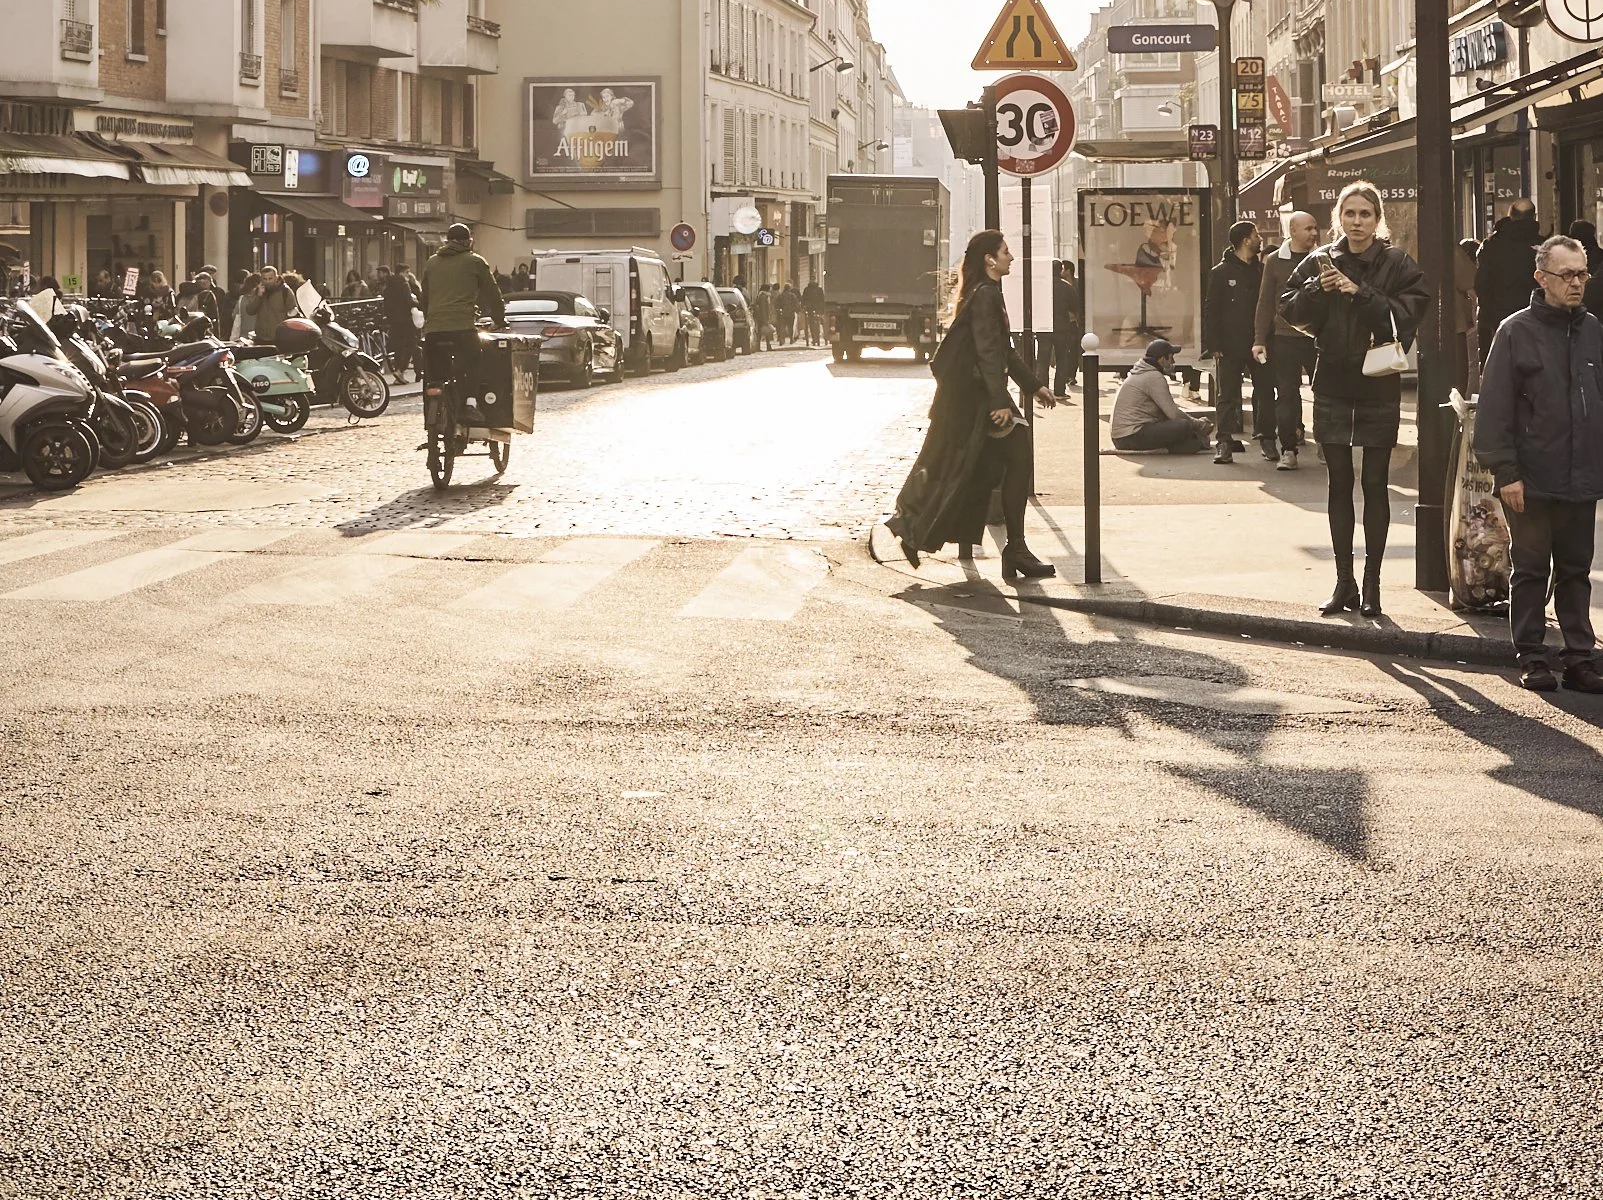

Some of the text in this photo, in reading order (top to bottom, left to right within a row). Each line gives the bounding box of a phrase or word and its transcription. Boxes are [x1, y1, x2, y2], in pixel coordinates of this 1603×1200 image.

[1131, 33, 1191, 45] Goncourt
[1240, 61, 1259, 74] 20
[1326, 86, 1371, 96] HOTEL
[1240, 94, 1260, 108] 75
[1272, 87, 1288, 122] TABAC
[997, 103, 1056, 146] 30
[553, 137, 629, 161] Affligem
[1391, 188, 1405, 198] 55
[1090, 202, 1194, 227] LOEWE
[1238, 210, 1256, 219] AR
[68, 277, 77, 286] 15
